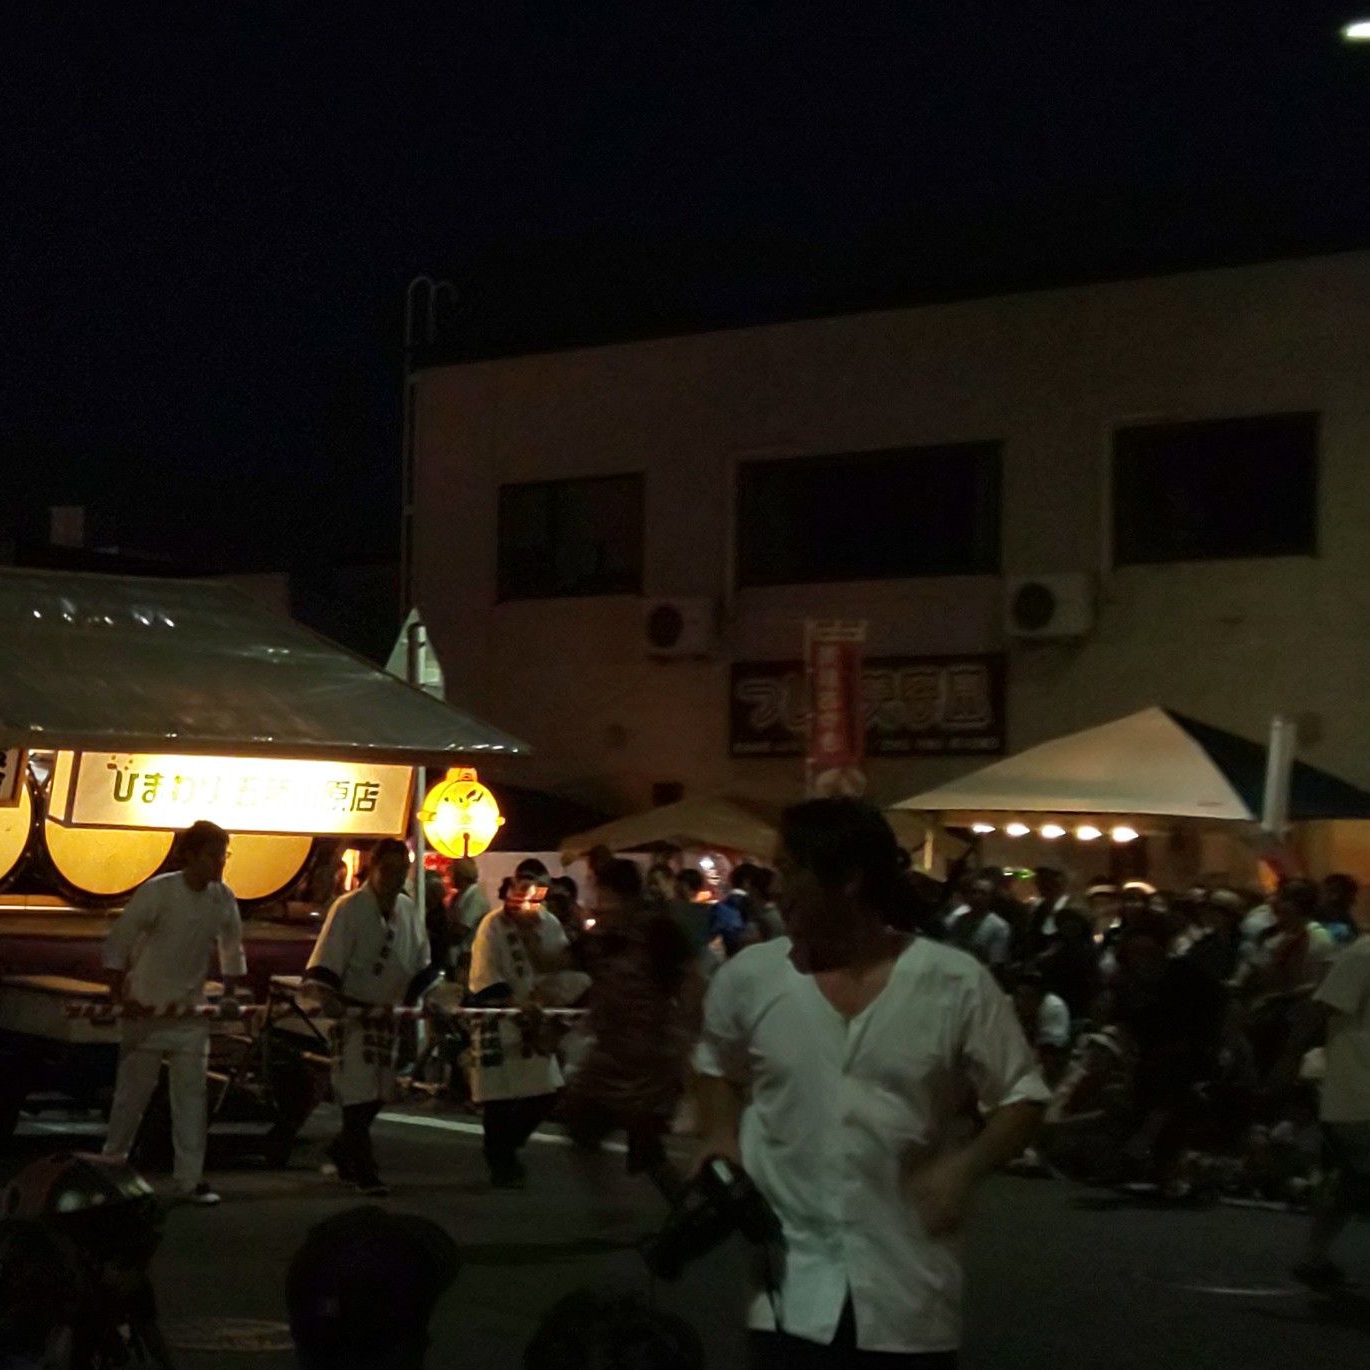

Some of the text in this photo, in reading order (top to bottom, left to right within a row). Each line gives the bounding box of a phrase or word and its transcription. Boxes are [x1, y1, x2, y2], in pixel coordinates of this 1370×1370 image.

[110, 765, 381, 812] ひまわり五原店
